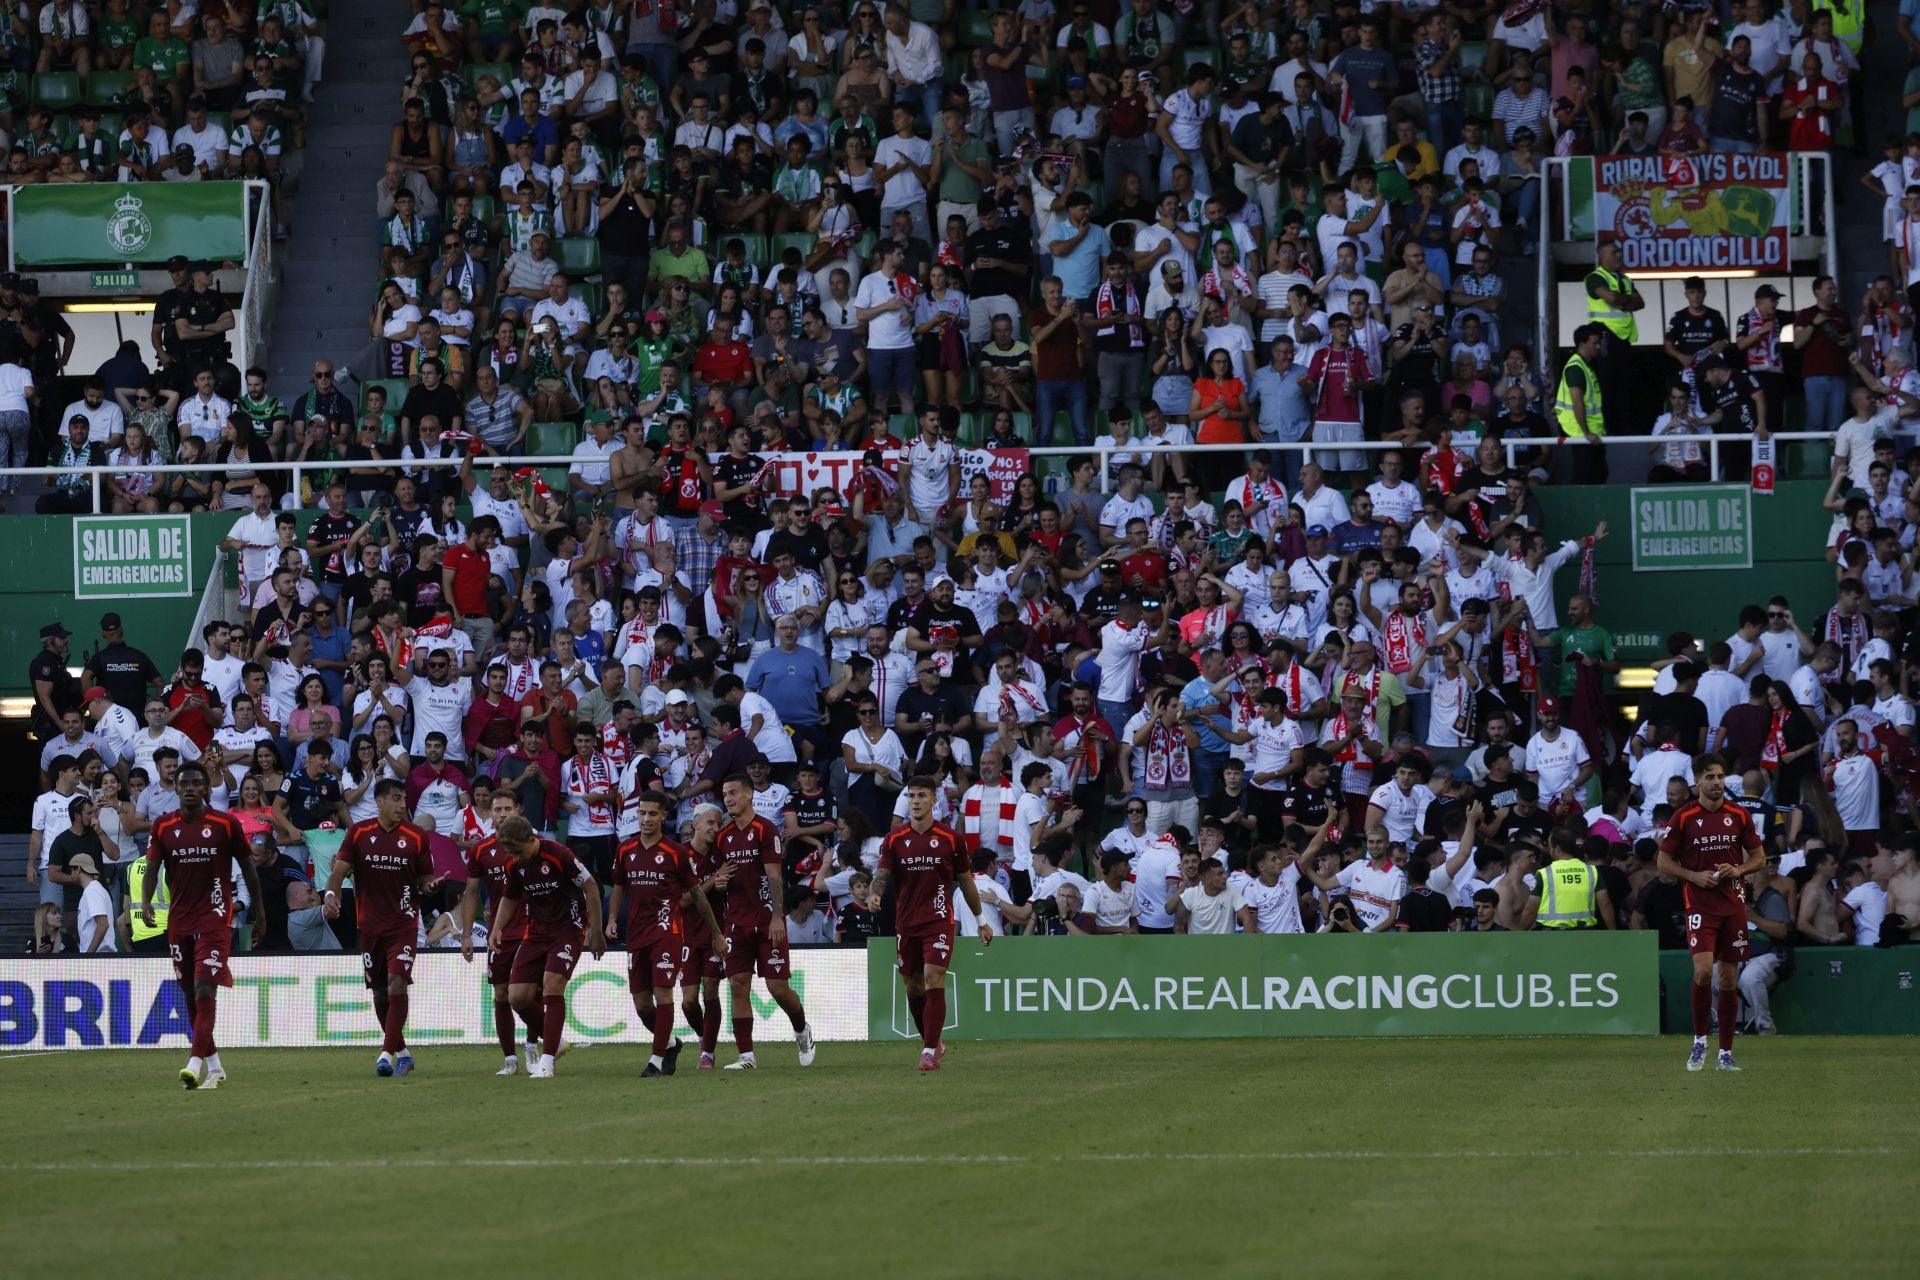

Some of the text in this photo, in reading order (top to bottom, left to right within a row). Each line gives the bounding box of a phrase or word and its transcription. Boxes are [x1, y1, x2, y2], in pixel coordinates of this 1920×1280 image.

[1601, 156, 1667, 185] RURAL
[1733, 154, 1784, 181] CYDL
[1614, 235, 1781, 268] ORDONCILLO
[95, 274, 135, 287] SALIDA
[1640, 498, 1742, 533] SALIDA DE
[83, 527, 183, 561] SALIDA DE
[1641, 536, 1744, 557] EMERGENCIAS
[83, 564, 184, 585] EMERGENCIAS
[1616, 635, 1659, 646] SALIDA
[1693, 835, 1737, 846] ASPIRE
[172, 846, 218, 857] ASPIRE
[364, 854, 409, 865] ASPIRE
[901, 856, 942, 865] ASPIRE
[1562, 874, 1582, 884] 195
[1688, 913, 1702, 931] 19
[975, 973, 1619, 1012] TIENDA.REALRACINGCLUB.ES
